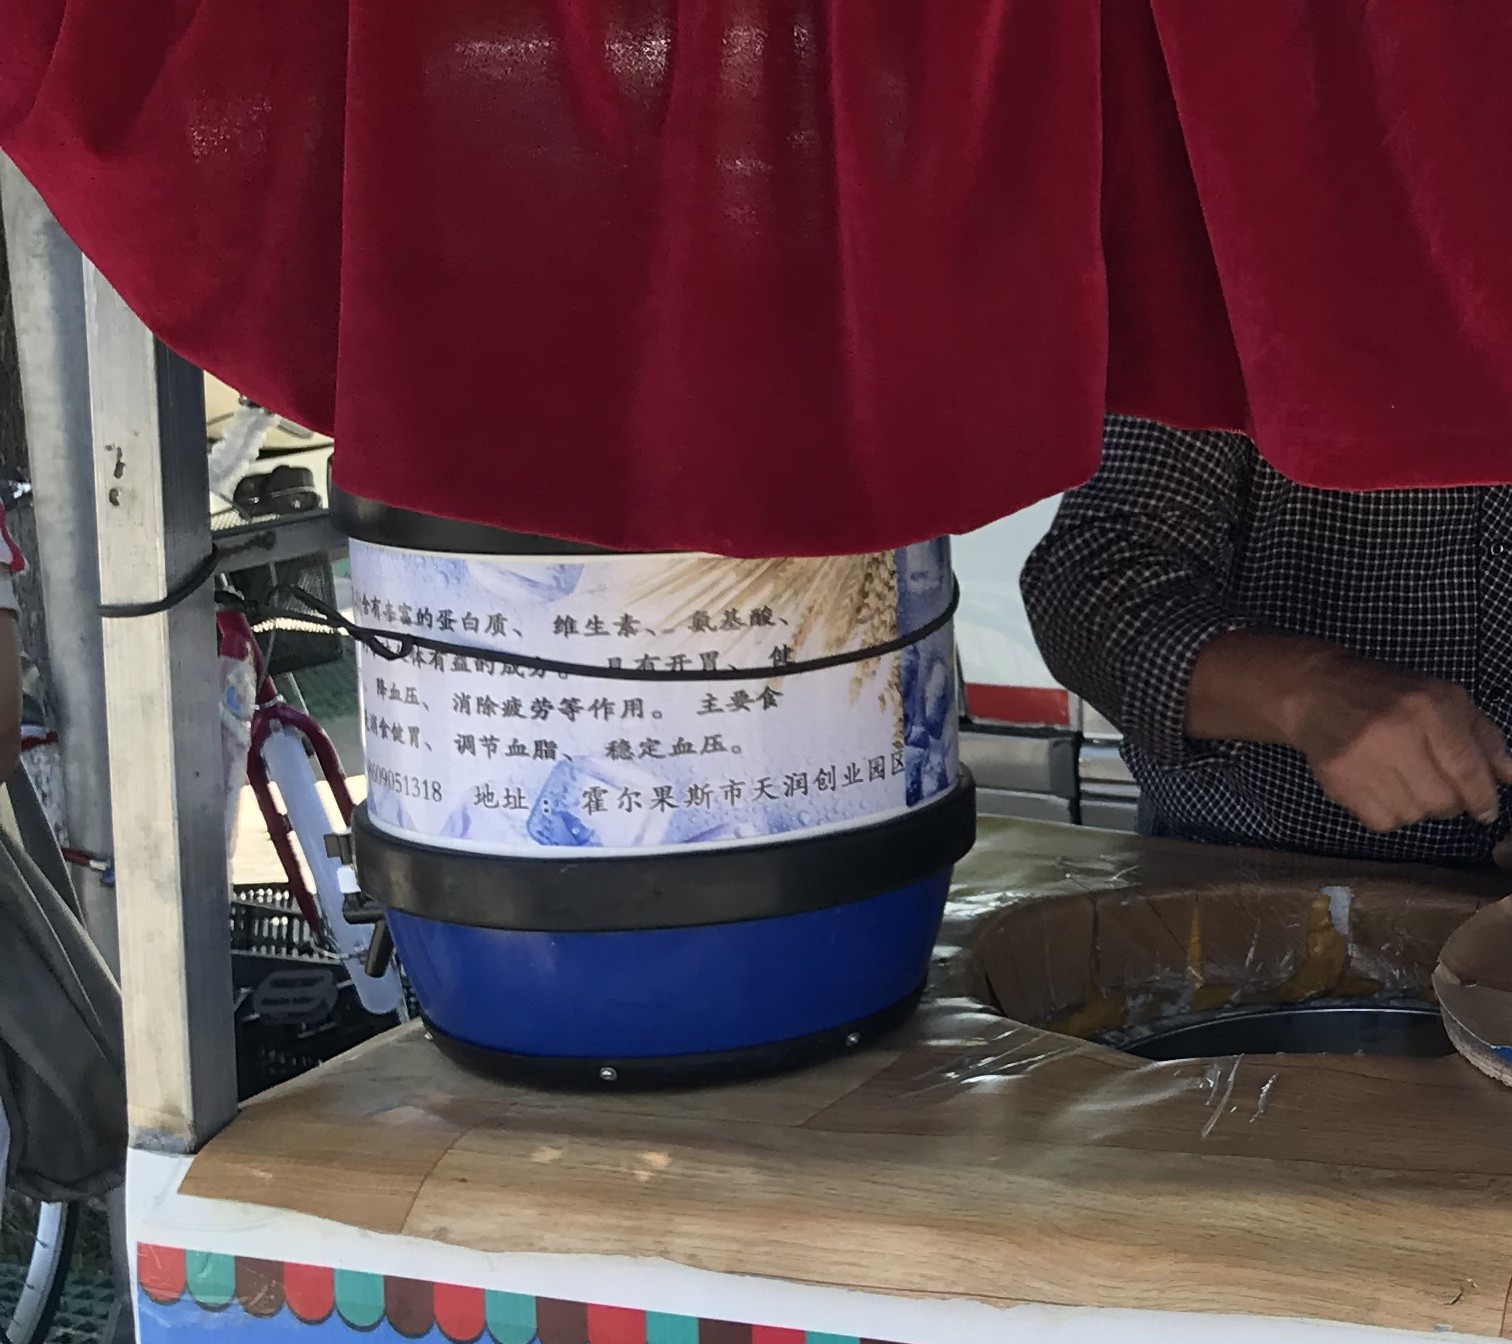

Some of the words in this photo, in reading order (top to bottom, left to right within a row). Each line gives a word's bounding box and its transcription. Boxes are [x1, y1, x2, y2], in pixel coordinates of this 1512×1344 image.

[554, 613, 657, 637] 维生素、
[697, 685, 784, 716] 主要食
[454, 733, 574, 763] 调节血脂、
[604, 734, 744, 761] 稳定血压。
[581, 749, 906, 817] 霍尔果斯市天润创业园区
